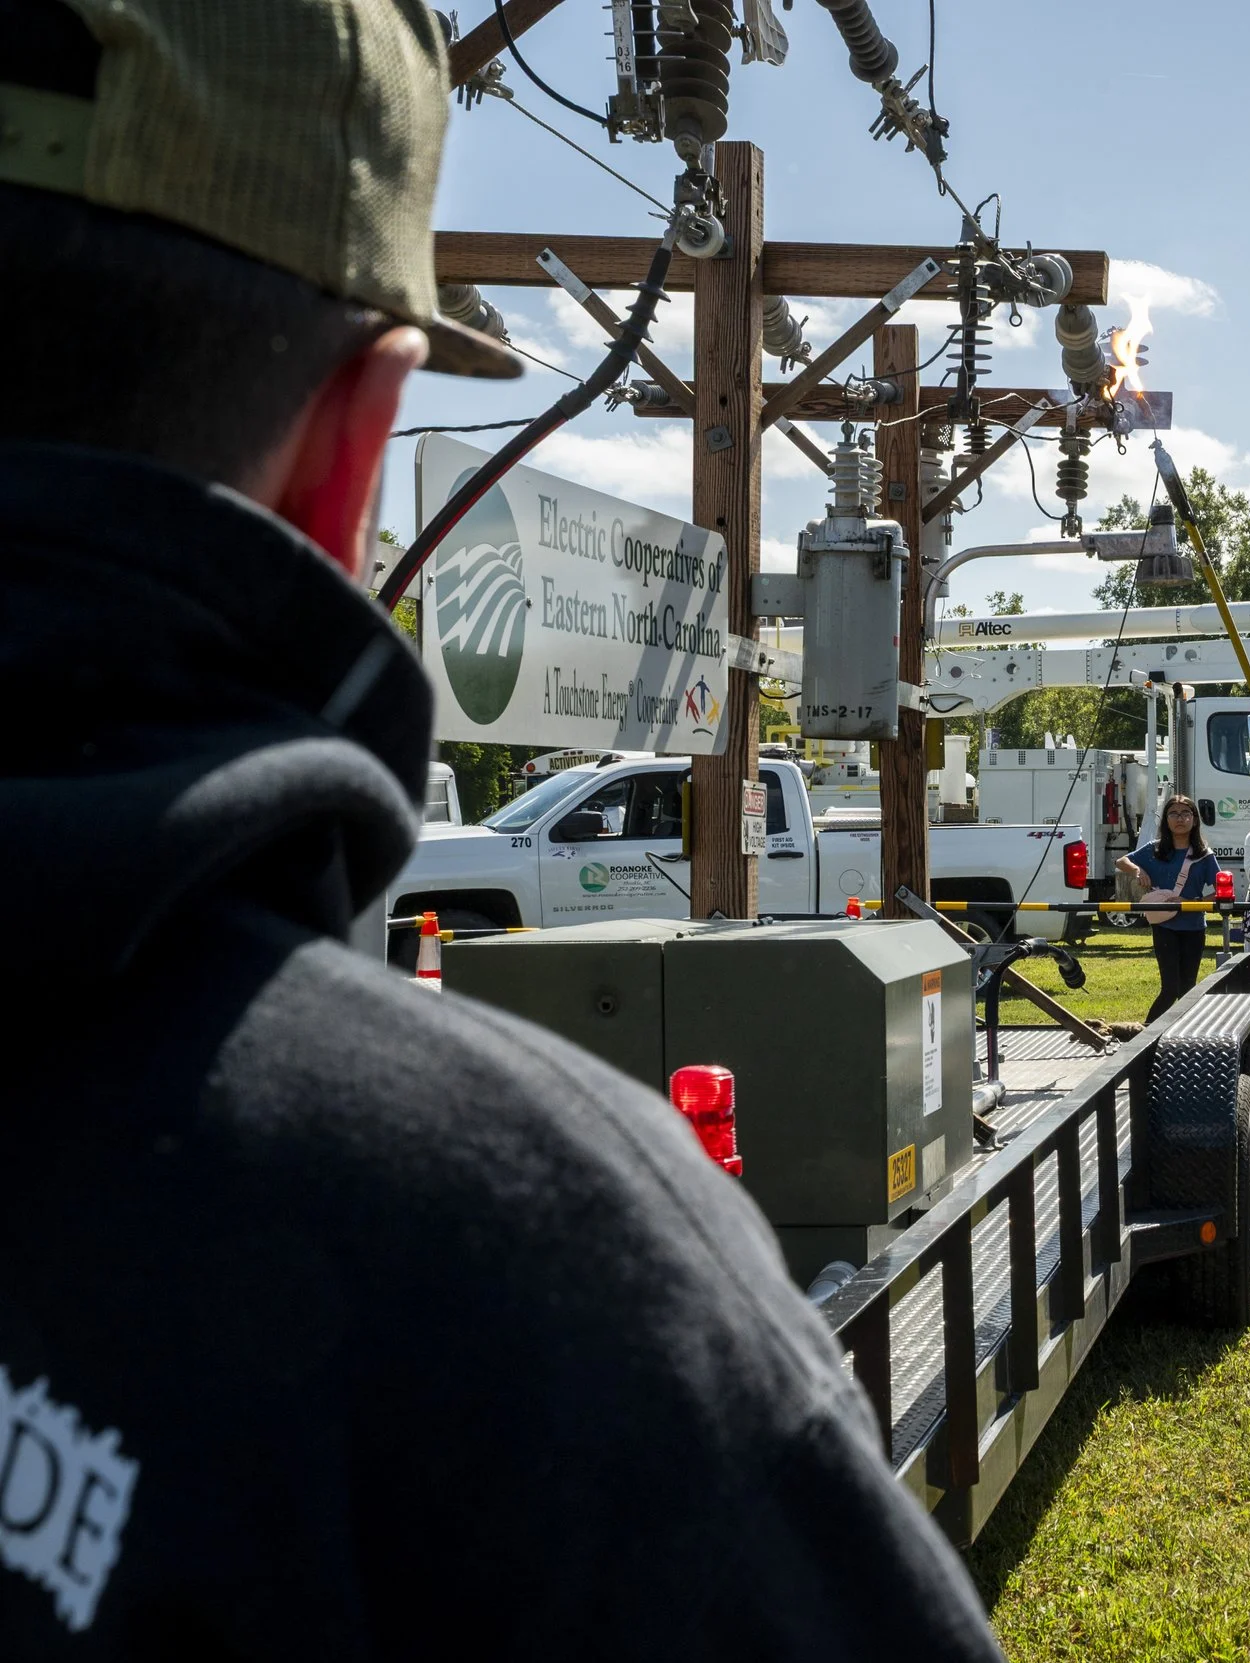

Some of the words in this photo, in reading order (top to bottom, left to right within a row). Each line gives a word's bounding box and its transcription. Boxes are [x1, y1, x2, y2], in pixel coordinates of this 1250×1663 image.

[619, 61, 632, 72] 16
[538, 493, 606, 563] Electric
[611, 517, 704, 588] Cooperatives
[709, 551, 722, 593] of
[541, 575, 608, 639] Eastern
[612, 592, 658, 647] North
[663, 604, 720, 659] Carolina
[975, 621, 1012, 636] Altec
[543, 666, 551, 714] A
[554, 666, 599, 719] Touchstone
[637, 678, 678, 733] Cooperative
[806, 705, 872, 719] TMS-2-17
[549, 755, 583, 770] ACTIVITY
[511, 837, 532, 848] 270
[1213, 847, 1233, 856] SDOT
[610, 865, 653, 873] ROANOKE
[893, 1150, 912, 1189] 25327
